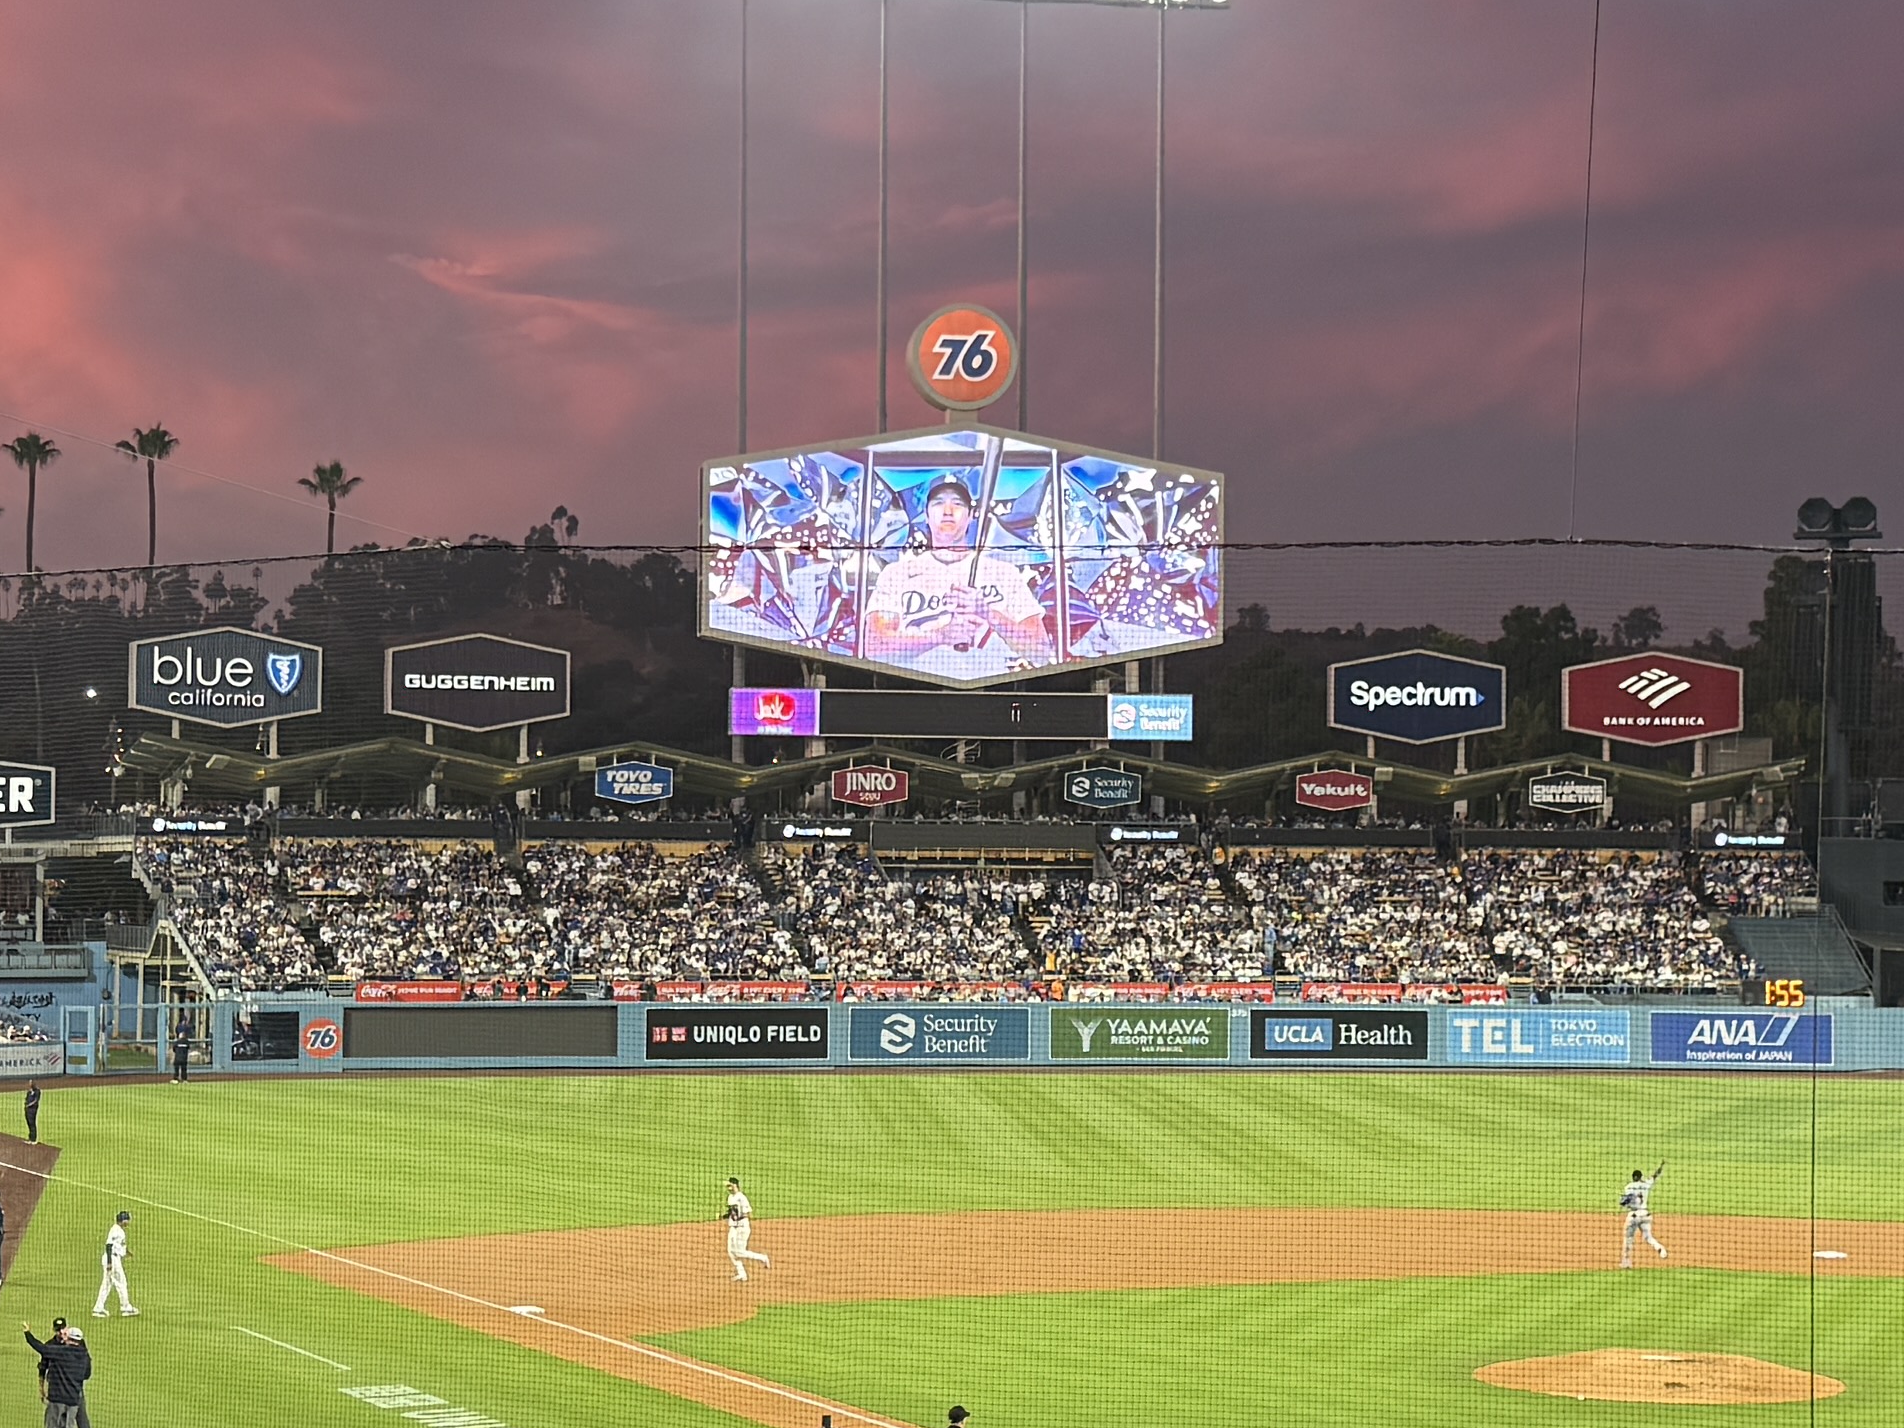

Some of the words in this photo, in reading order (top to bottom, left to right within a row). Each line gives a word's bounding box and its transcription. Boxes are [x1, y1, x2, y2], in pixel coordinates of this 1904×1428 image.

[932, 330, 998, 381] 76
[153, 646, 254, 688] blue
[404, 674, 555, 692] GUGGENHEIM
[168, 688, 265, 707] california
[1350, 680, 1473, 711] Spectrum
[1139, 703, 1187, 720] Security
[1139, 717, 1180, 731] Benefit
[1604, 717, 1633, 725] BANK
[1636, 717, 1651, 725] OF
[1652, 717, 1704, 726] AMERICA
[606, 770, 653, 783] TOYO
[845, 773, 896, 791] JINRO
[1093, 777, 1135, 791] Security
[613, 782, 664, 795] TIRES
[1093, 787, 1130, 799] Benefit
[1300, 782, 1368, 798] Yakult
[1765, 979, 1805, 1007] 1:55
[923, 1015, 997, 1036] Security
[1551, 1020, 1597, 1032] TOKYO
[1687, 1019, 1757, 1046] ANA
[307, 1025, 337, 1050] 76
[692, 1025, 761, 1045] UNIQLO
[765, 1025, 820, 1043] FIELD
[923, 1034, 989, 1054] Benefit
[1110, 1036, 1151, 1045] RESORT
[1152, 1036, 1161, 1045] &
[1162, 1036, 1209, 1046] CASINO
[1273, 1025, 1325, 1045] UCLA
[1339, 1023, 1413, 1047] Health
[1453, 1018, 1535, 1054] TEL
[1551, 1034, 1624, 1047] ELECTRON
[1686, 1050, 1744, 1062] Inspiration
[1746, 1050, 1757, 1061] of
[1757, 1051, 1793, 1062] JAPAN
